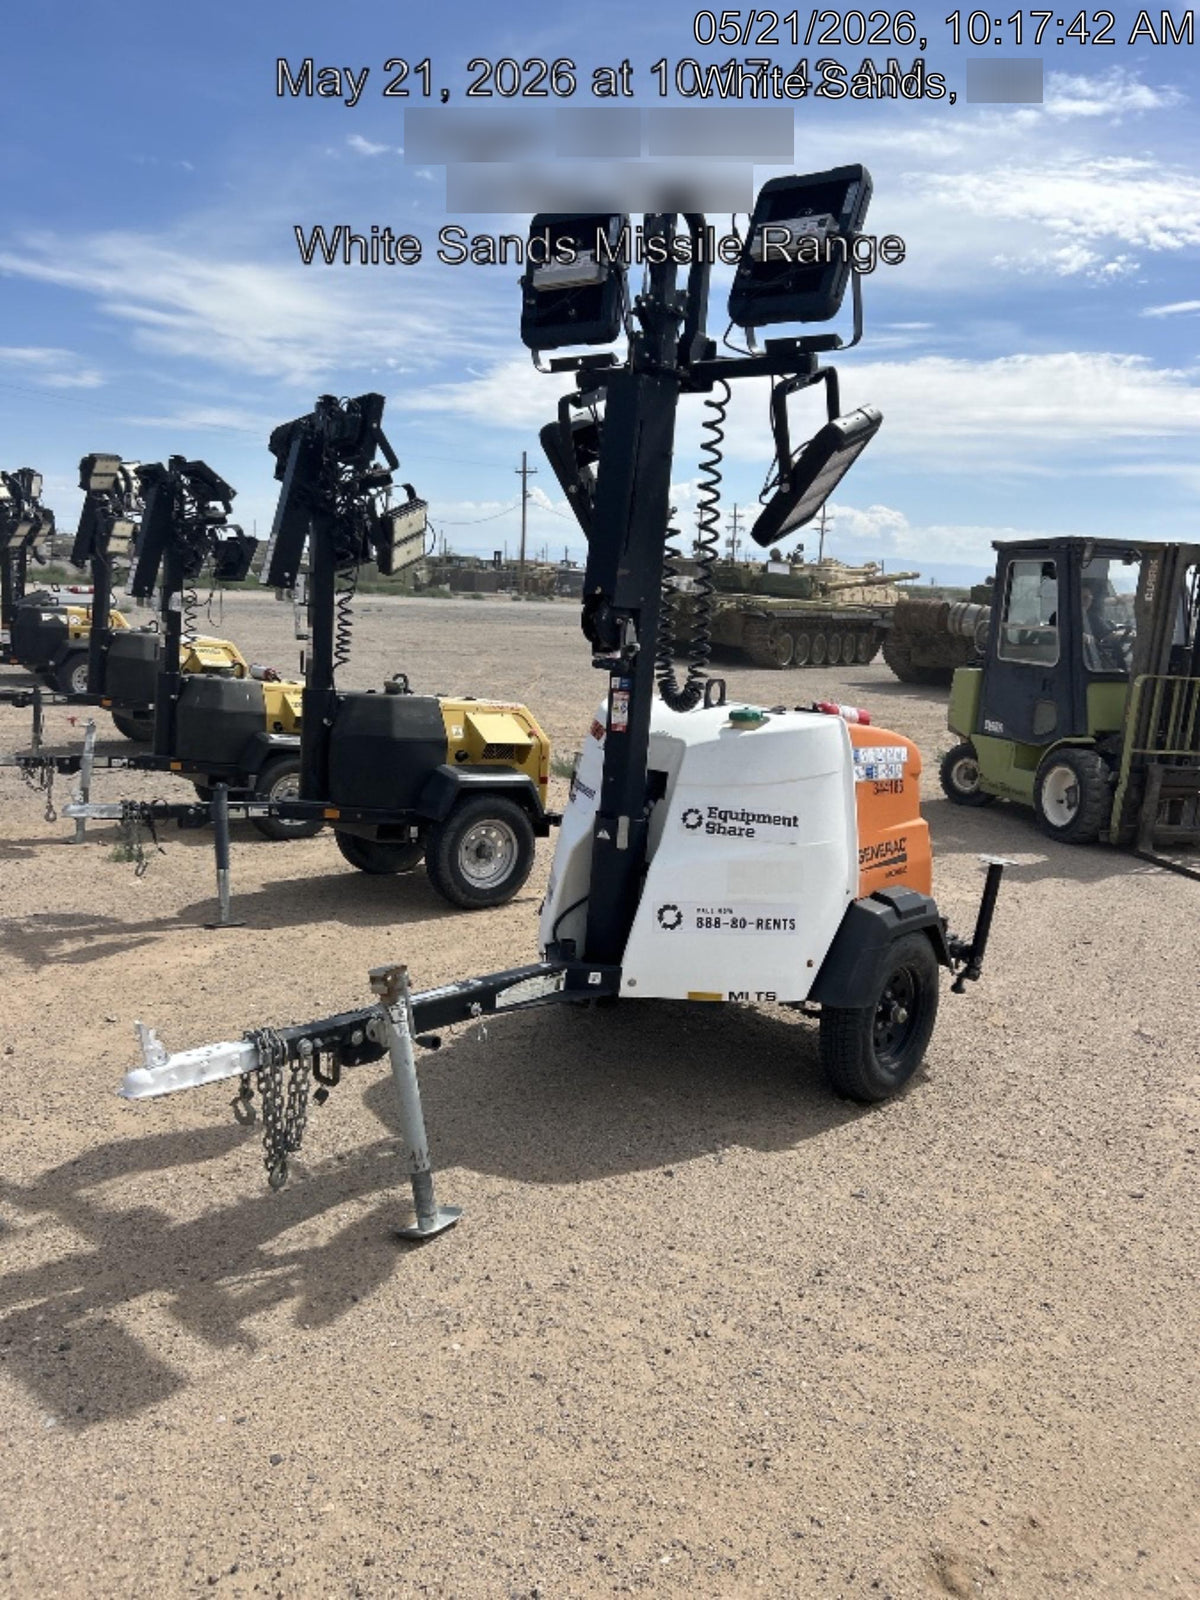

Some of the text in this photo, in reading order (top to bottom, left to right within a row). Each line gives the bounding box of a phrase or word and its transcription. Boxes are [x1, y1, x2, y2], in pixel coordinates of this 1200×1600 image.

[707, 806, 799, 828] Equipment
[705, 821, 755, 838] Share
[859, 837, 908, 865] GENERAC
[696, 917, 796, 931] 888-80-RENTS
